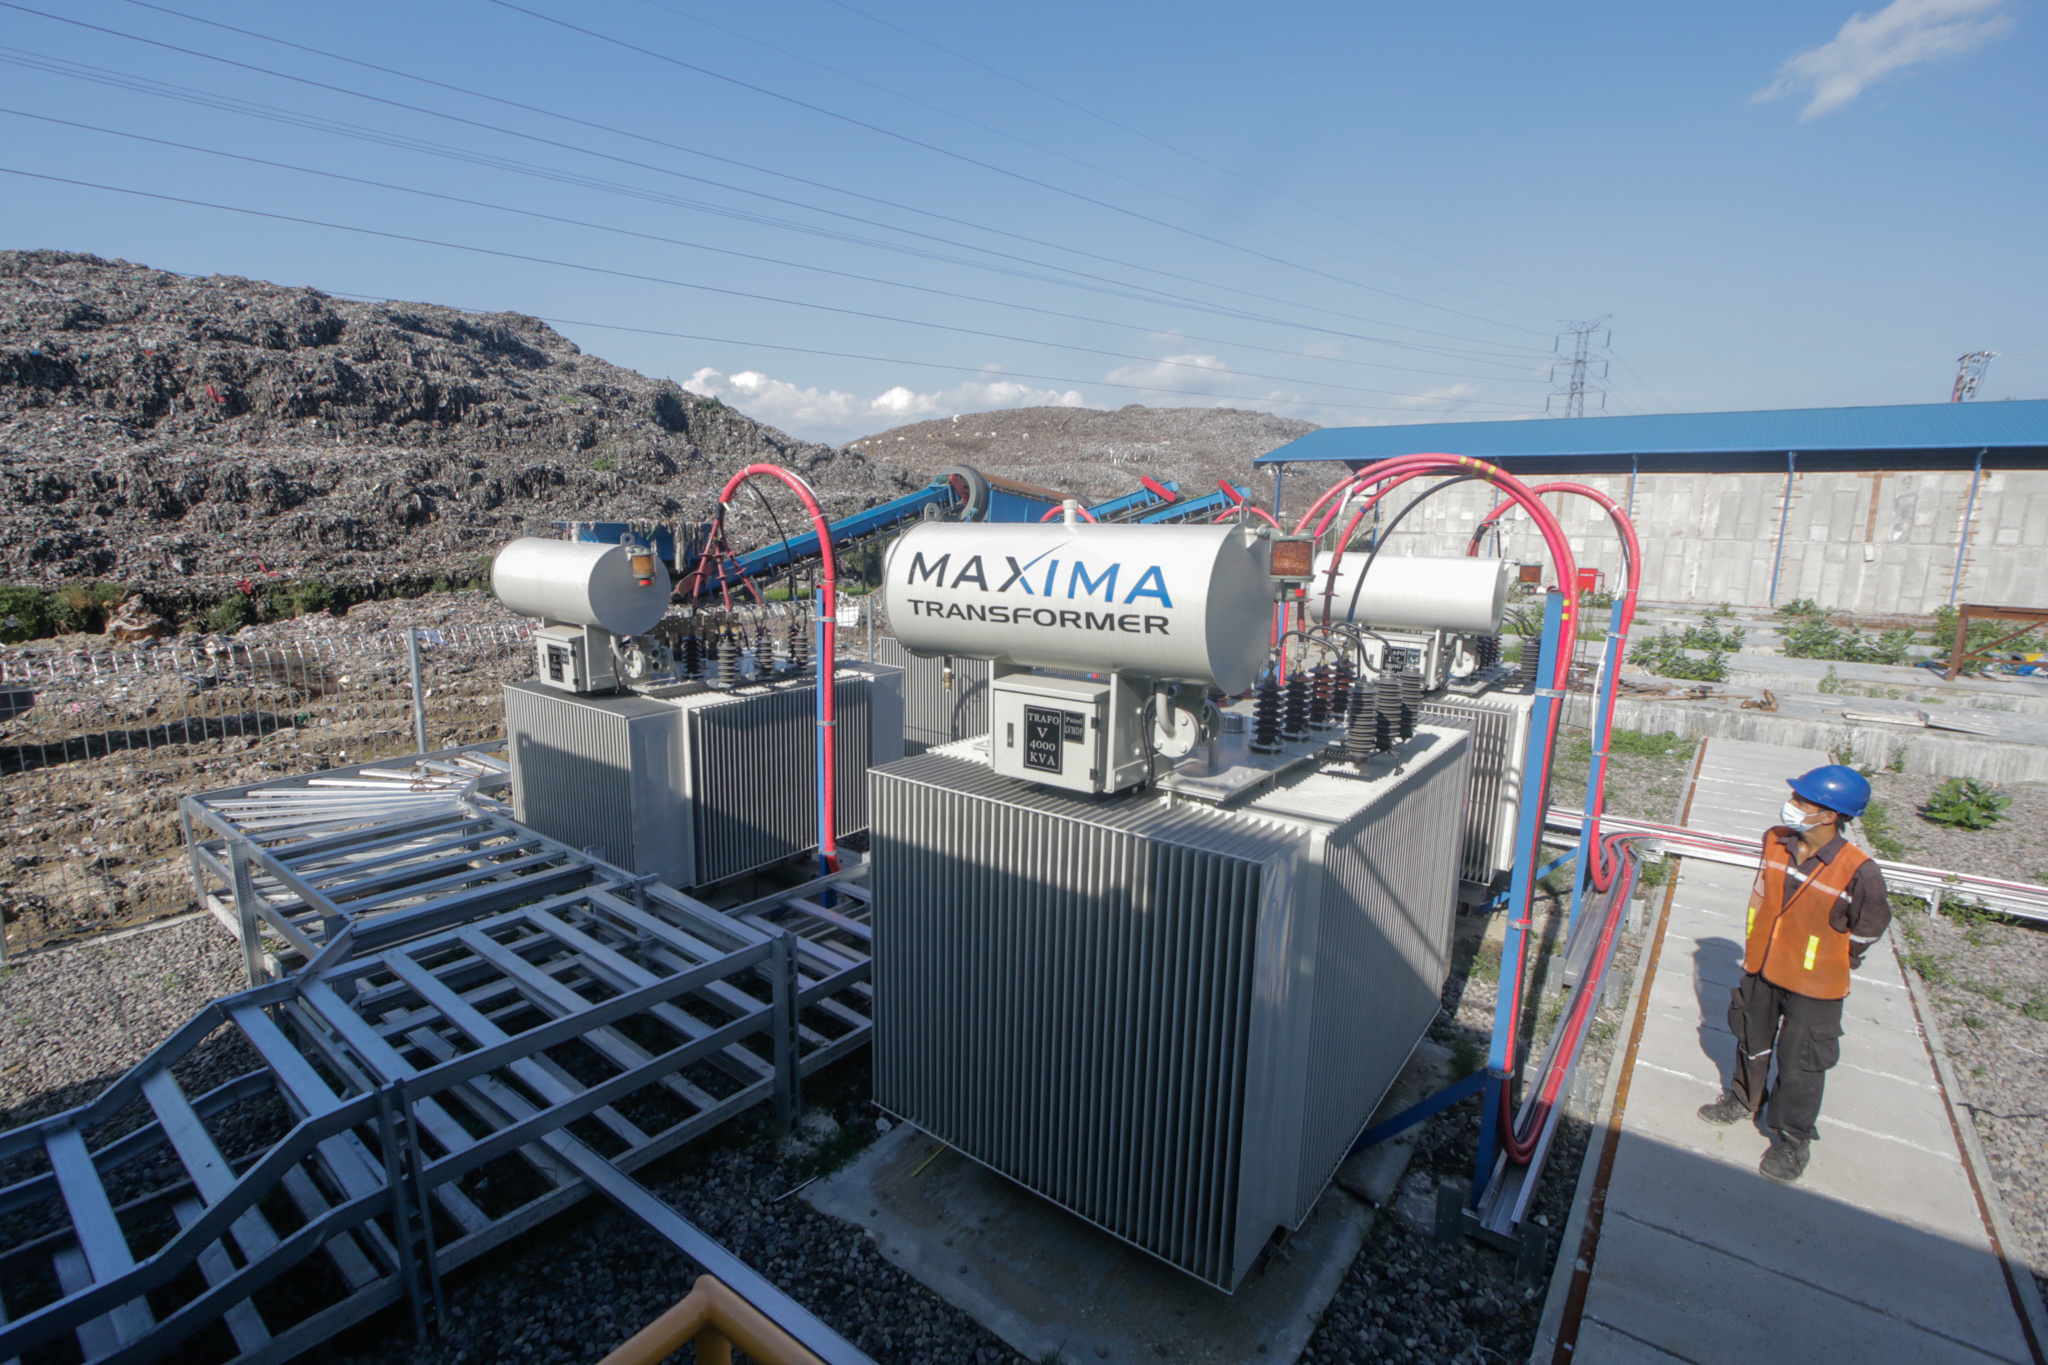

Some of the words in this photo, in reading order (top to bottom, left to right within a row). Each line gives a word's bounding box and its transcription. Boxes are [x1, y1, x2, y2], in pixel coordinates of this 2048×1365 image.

[908, 540, 1173, 609] MAXIMA
[907, 599, 1170, 635] TRANSFORMER
[1028, 712, 1060, 725] TRAFO
[1066, 716, 1083, 725] Panel
[1036, 727, 1048, 738] V
[1065, 725, 1083, 736] LVMDP
[1029, 739, 1056, 752] 4000
[1029, 752, 1056, 766] KVA
